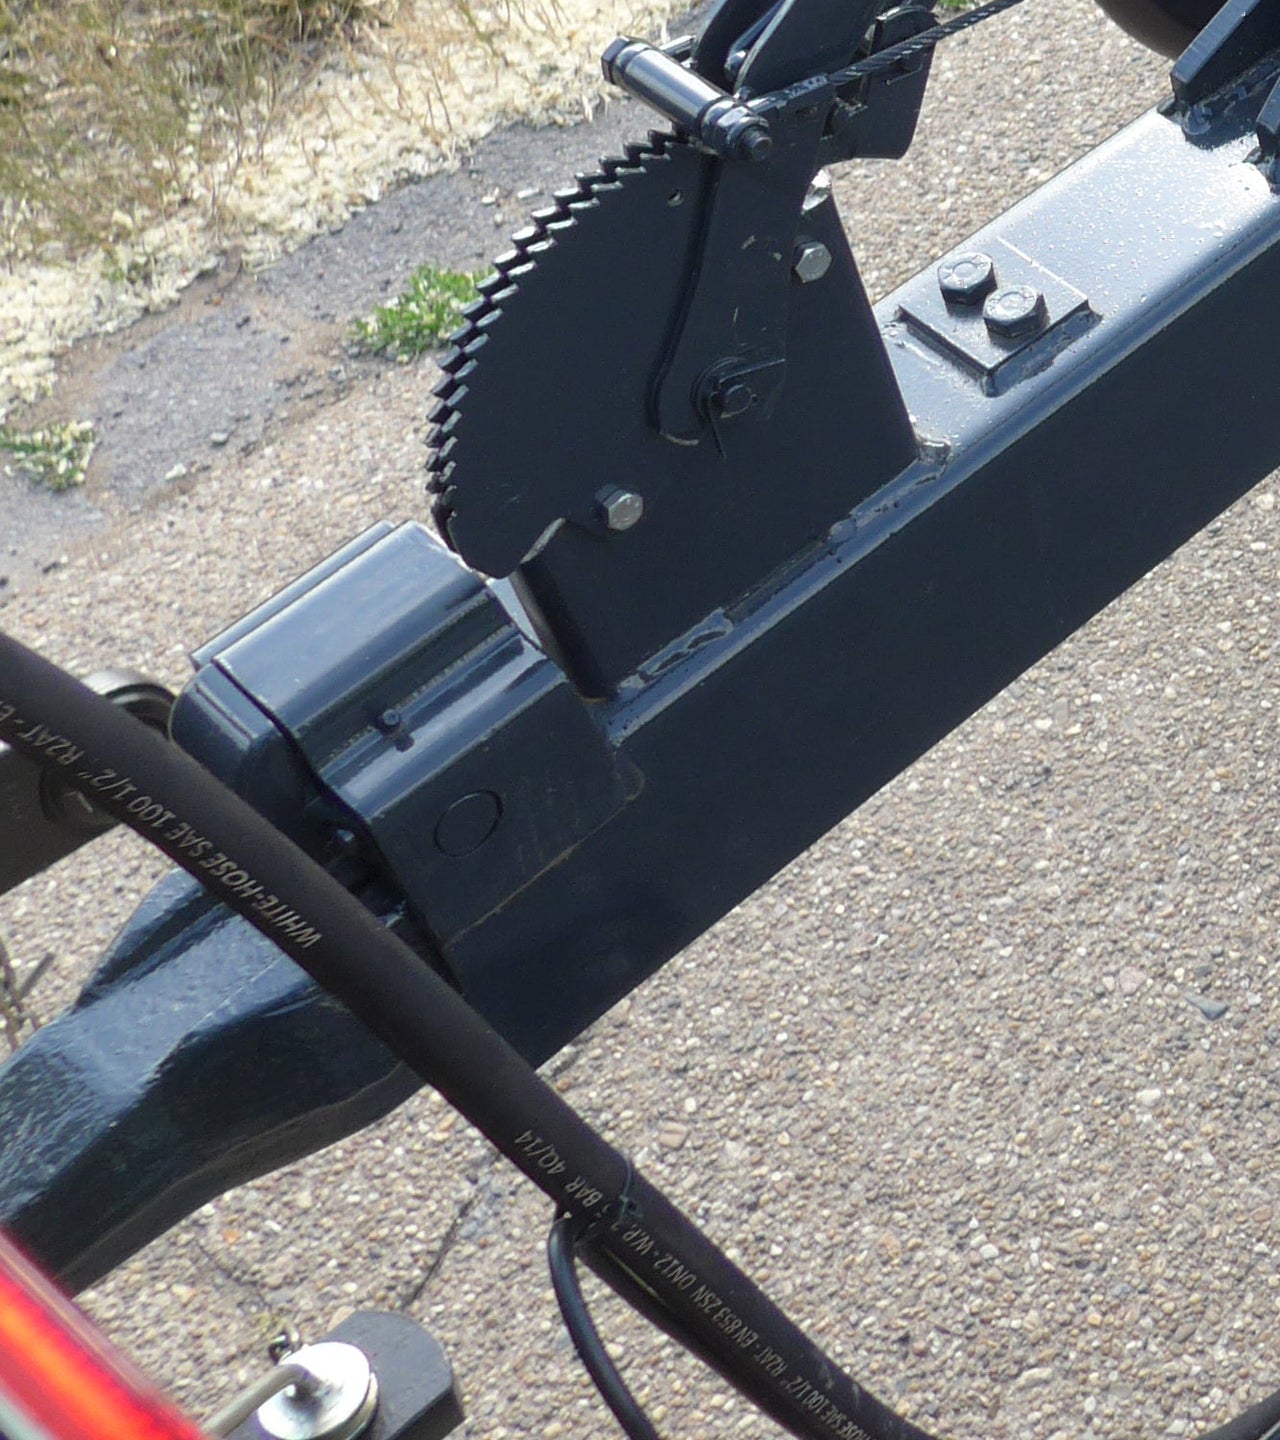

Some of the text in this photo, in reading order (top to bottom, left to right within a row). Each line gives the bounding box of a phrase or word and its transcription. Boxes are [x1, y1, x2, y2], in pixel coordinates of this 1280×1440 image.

[17, 725, 84, 765] R2AT
[127, 796, 176, 827] 100
[166, 822, 213, 856] SAE
[200, 853, 322, 947] WHITE-HOSE
[565, 1176, 603, 1207] BAR
[654, 1253, 696, 1289] DN12
[691, 1284, 722, 1313] 2SN
[713, 1307, 742, 1333] 853
[733, 1326, 758, 1347] EN
[754, 1346, 787, 1376] R2AT
[802, 1390, 829, 1413] 100
